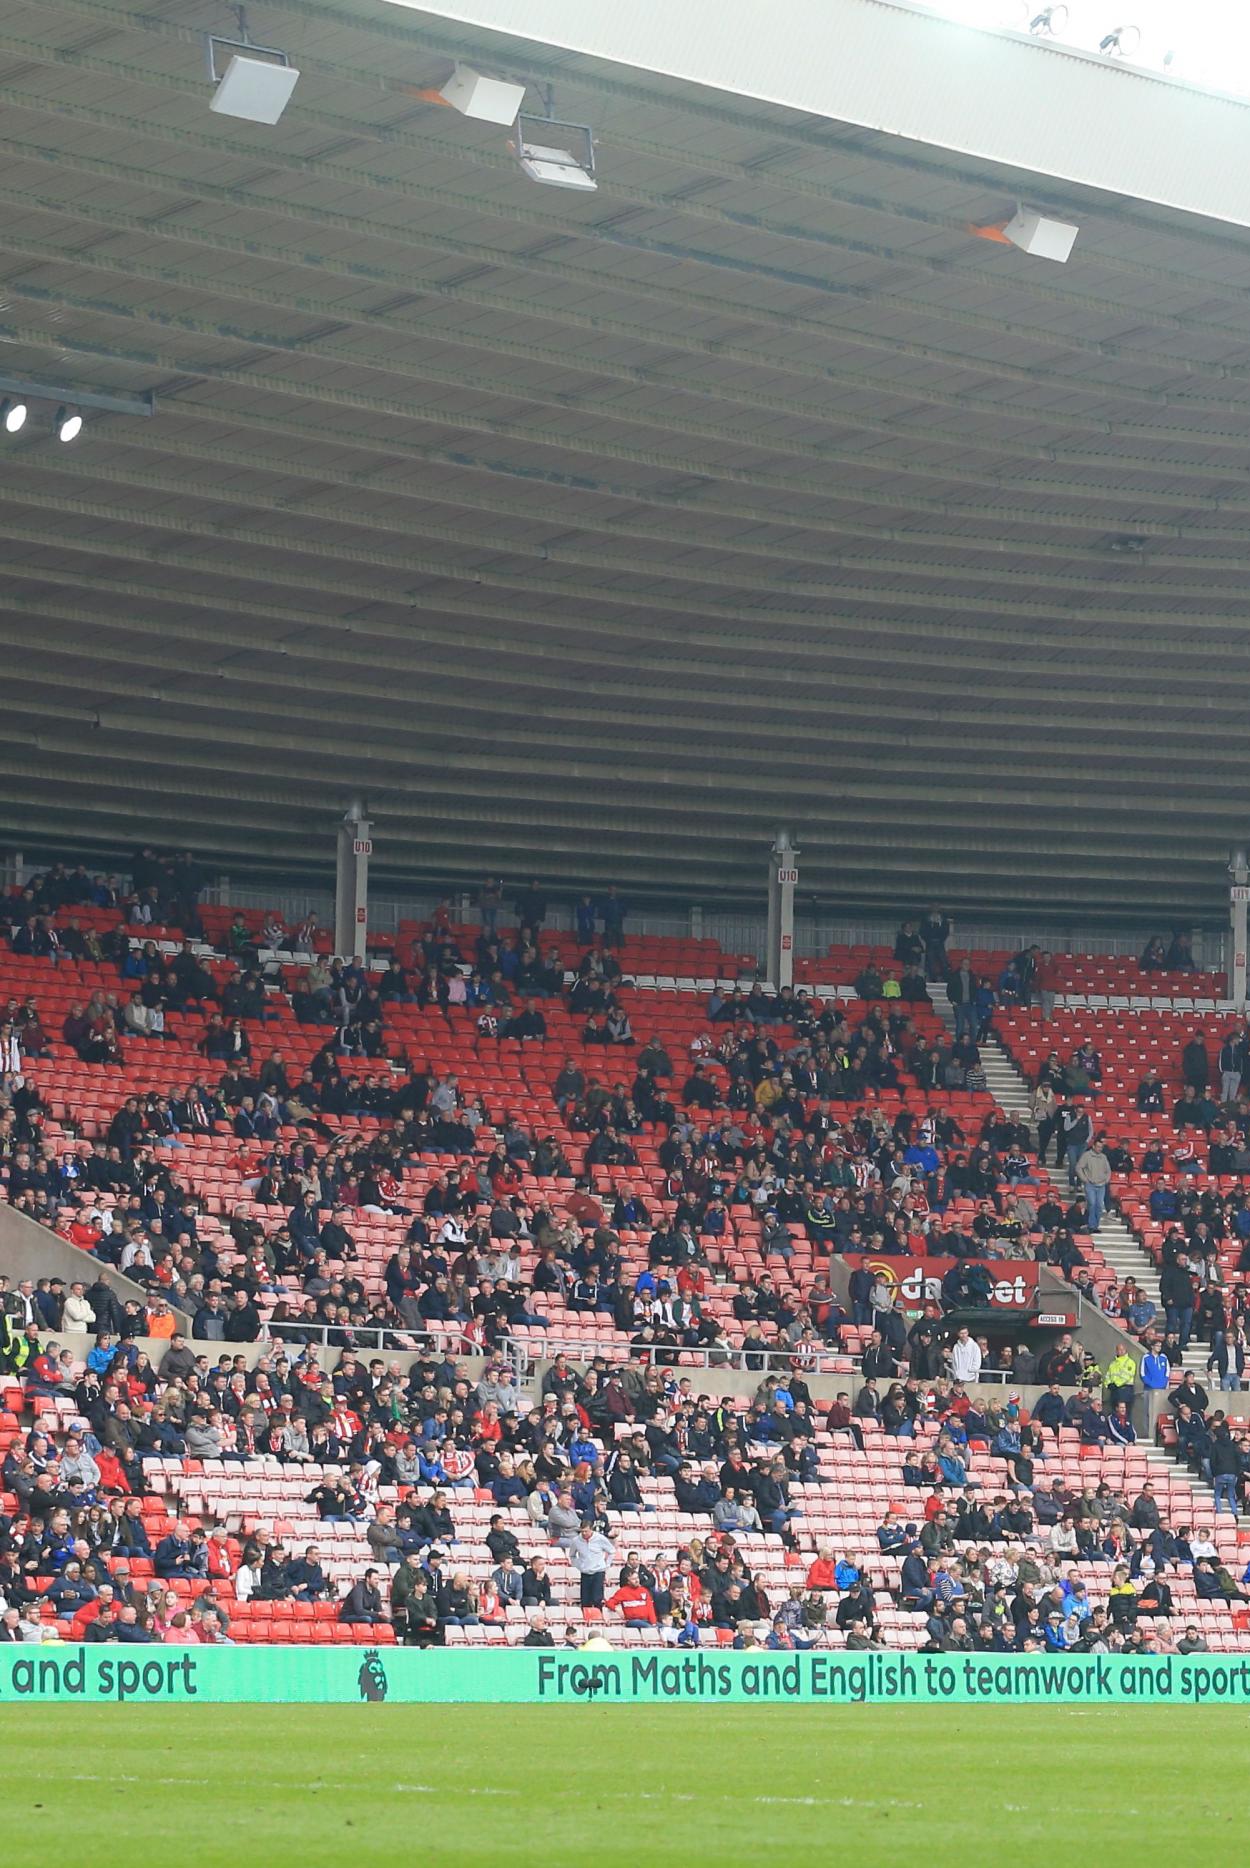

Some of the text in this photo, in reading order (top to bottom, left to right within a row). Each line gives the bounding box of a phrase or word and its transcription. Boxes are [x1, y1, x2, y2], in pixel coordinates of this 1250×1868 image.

[355, 841, 370, 852] U10
[780, 870, 796, 882] U10
[901, 1267, 1026, 1304] daet
[12, 1648, 197, 1701] and sport
[538, 1656, 621, 1695] From
[632, 1654, 731, 1695] Maths
[742, 1655, 800, 1695] and
[812, 1655, 916, 1702] English
[925, 1657, 956, 1696] to
[963, 1655, 1112, 1696] teamwork
[1120, 1654, 1172, 1696] and
